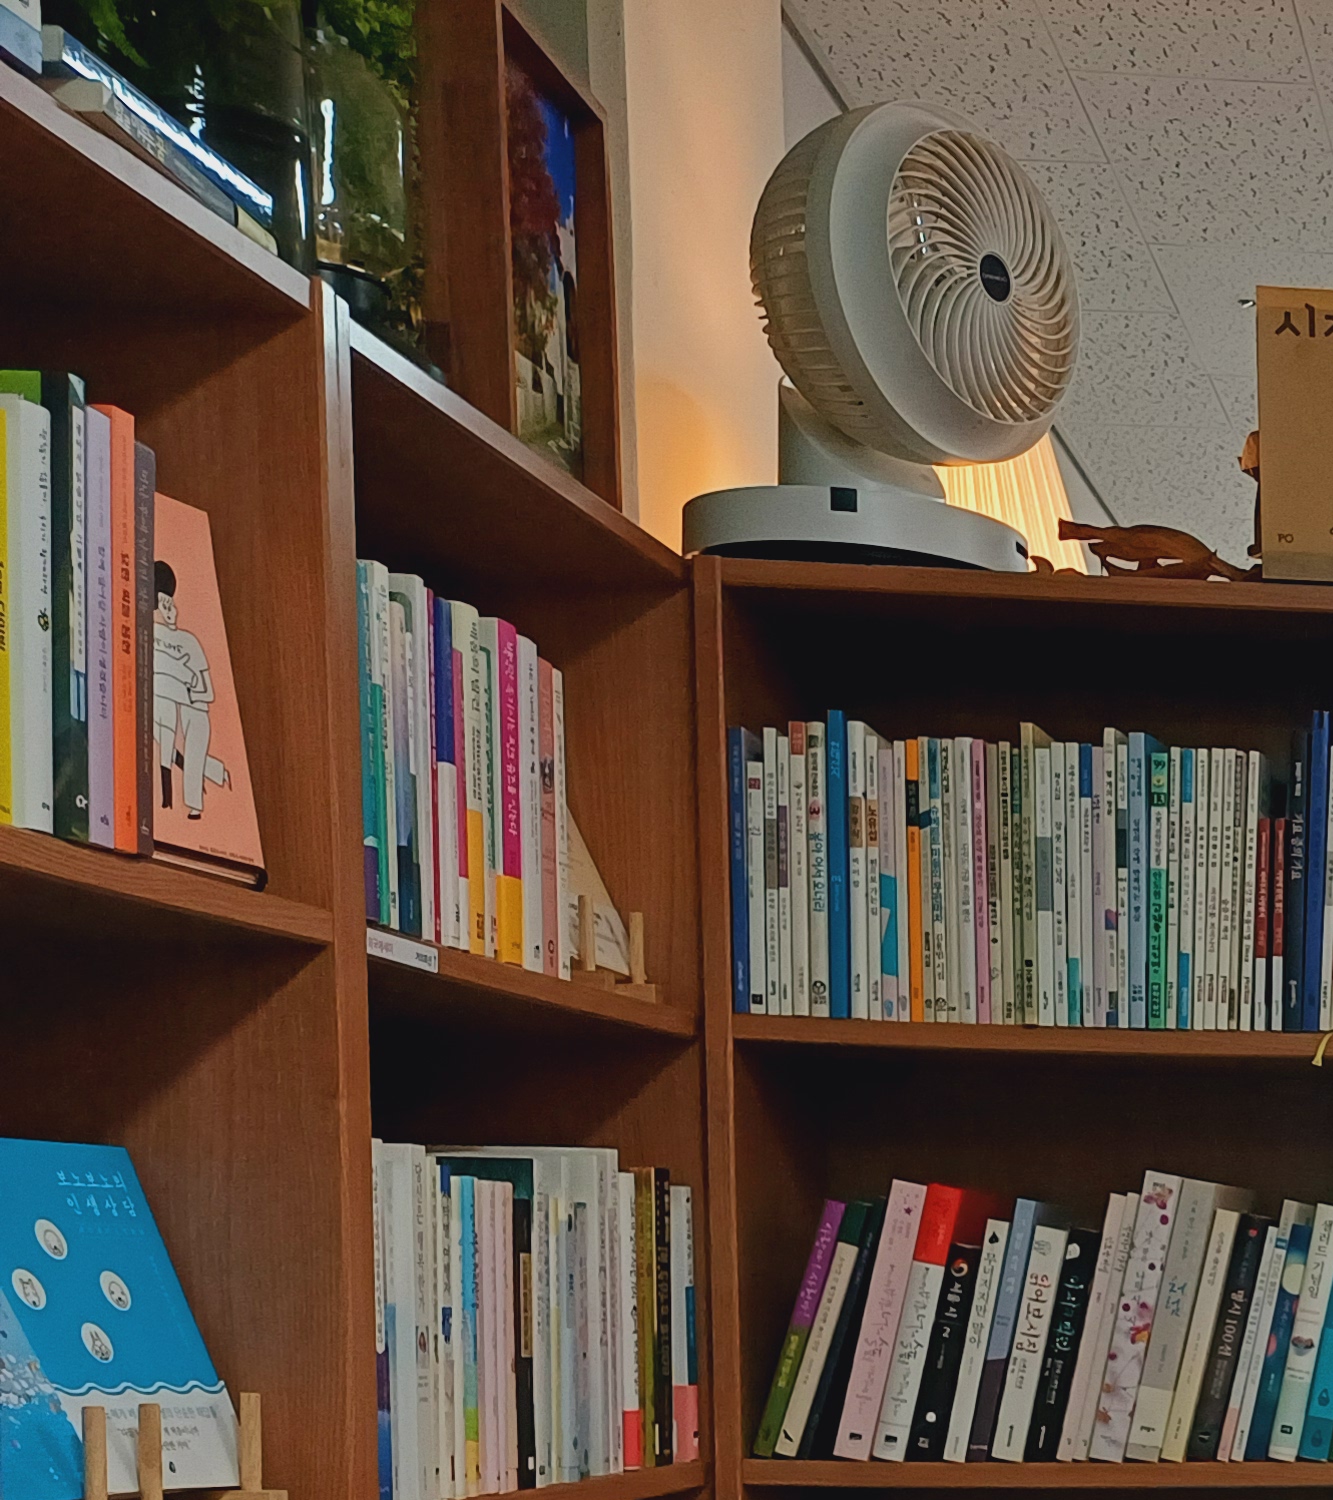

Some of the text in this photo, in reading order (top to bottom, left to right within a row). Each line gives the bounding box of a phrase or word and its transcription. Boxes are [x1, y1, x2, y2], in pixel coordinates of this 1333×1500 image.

[57, 1171, 128, 1190] 보노보노의
[67, 1193, 137, 1217] 인생상담
[1016, 1273, 1049, 1353] 읽어보시집
[1218, 1289, 1245, 1356] 명시 100선
